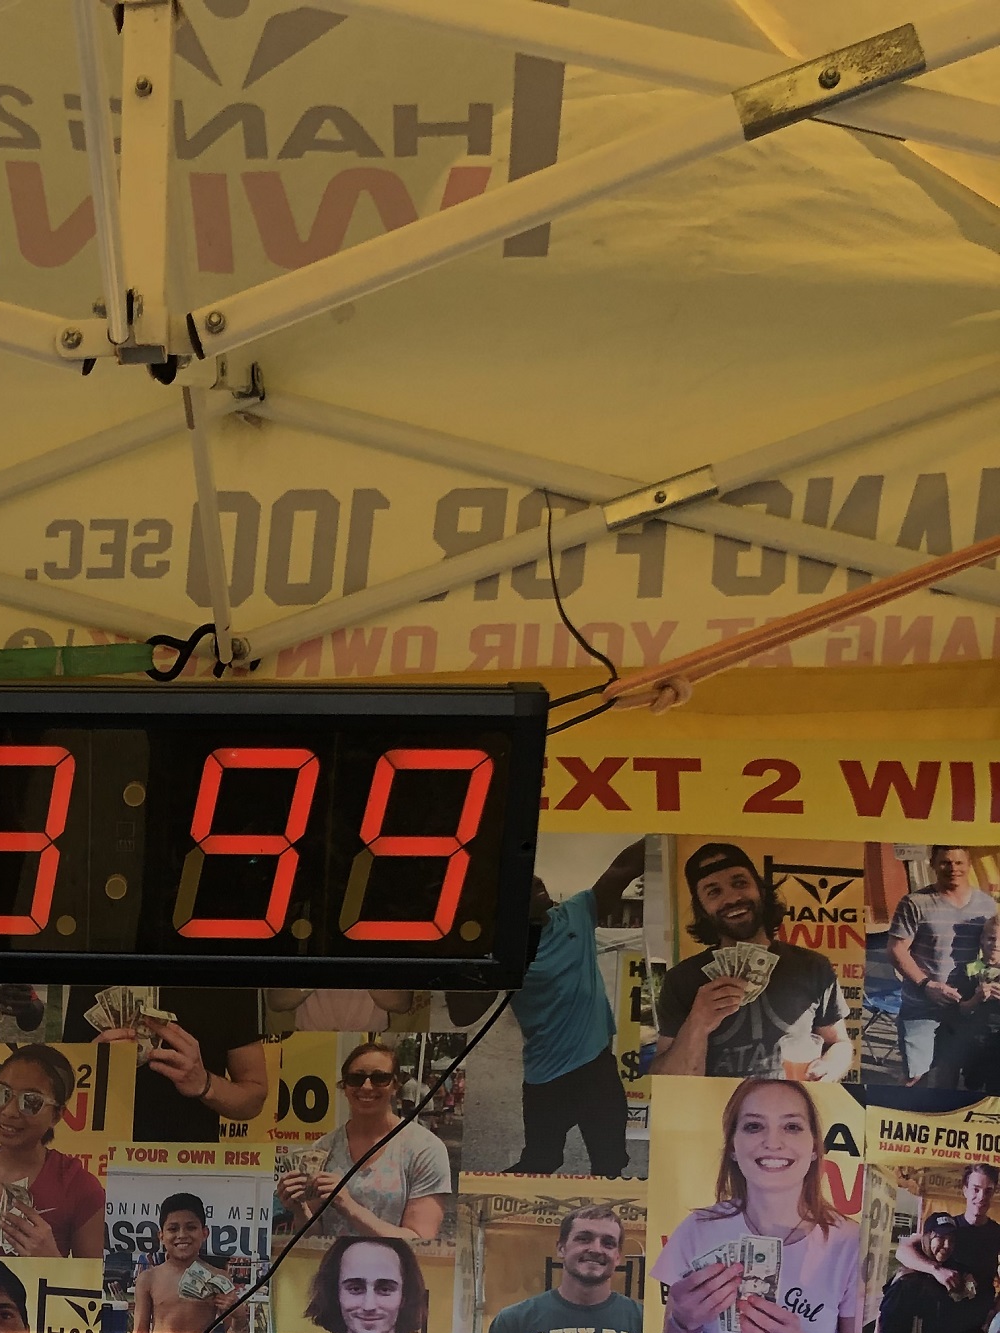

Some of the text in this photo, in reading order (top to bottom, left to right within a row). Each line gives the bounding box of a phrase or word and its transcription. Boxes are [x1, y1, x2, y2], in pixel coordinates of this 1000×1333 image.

[741, 758, 804, 814] 2
[228, 1123, 249, 1138] BAR
[880, 1119, 930, 1144] HANG
[934, 1127, 969, 1150] FOR
[125, 1147, 169, 1164] YOUR
[177, 1149, 216, 1165] OWN
[224, 1151, 261, 1166] RISK
[931, 1147, 961, 1160] YOUR
